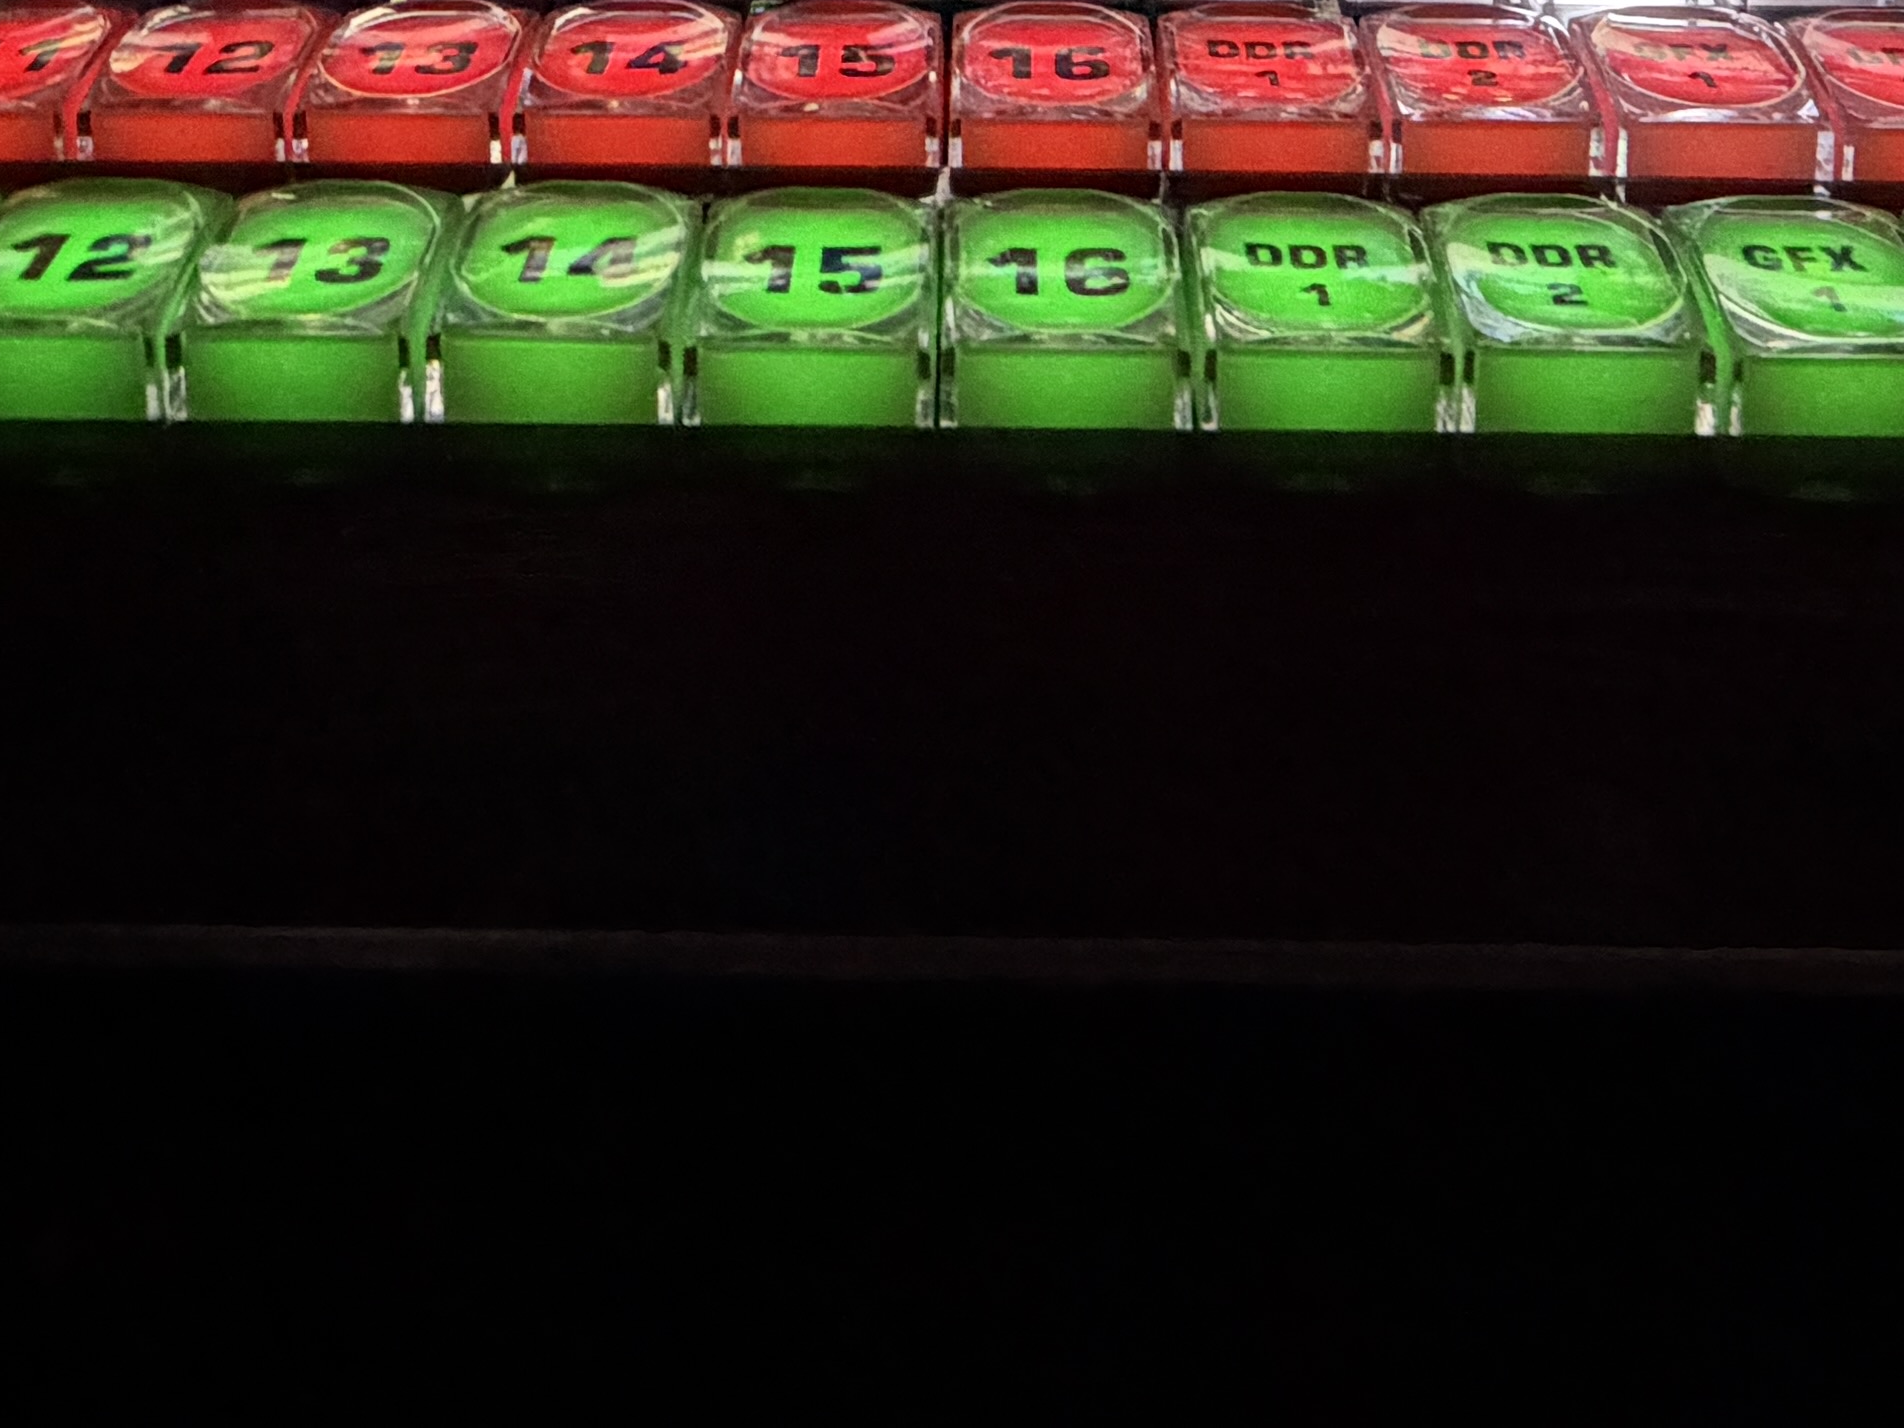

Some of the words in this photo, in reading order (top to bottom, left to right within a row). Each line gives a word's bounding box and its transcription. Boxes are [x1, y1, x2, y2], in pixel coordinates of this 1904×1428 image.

[143, 38, 276, 75] 12
[358, 41, 479, 75] 13
[568, 41, 691, 76] 14
[776, 43, 899, 79] 15
[987, 44, 1114, 81] 16
[1206, 38, 1316, 60] DDR
[1254, 68, 1282, 87] 1
[1467, 68, 1501, 87] 2
[1687, 70, 1719, 89] 1
[10, 232, 156, 282] 12
[251, 236, 392, 284] 13
[500, 235, 641, 284] 14
[742, 245, 884, 294] 15
[986, 246, 1133, 297] 16
[1244, 242, 1369, 270] DDR
[1485, 242, 1617, 270] DDR
[1740, 244, 1869, 273] GFX
[1299, 282, 1333, 307] 1
[1547, 281, 1589, 307] 2
[1811, 285, 1847, 313] 1
